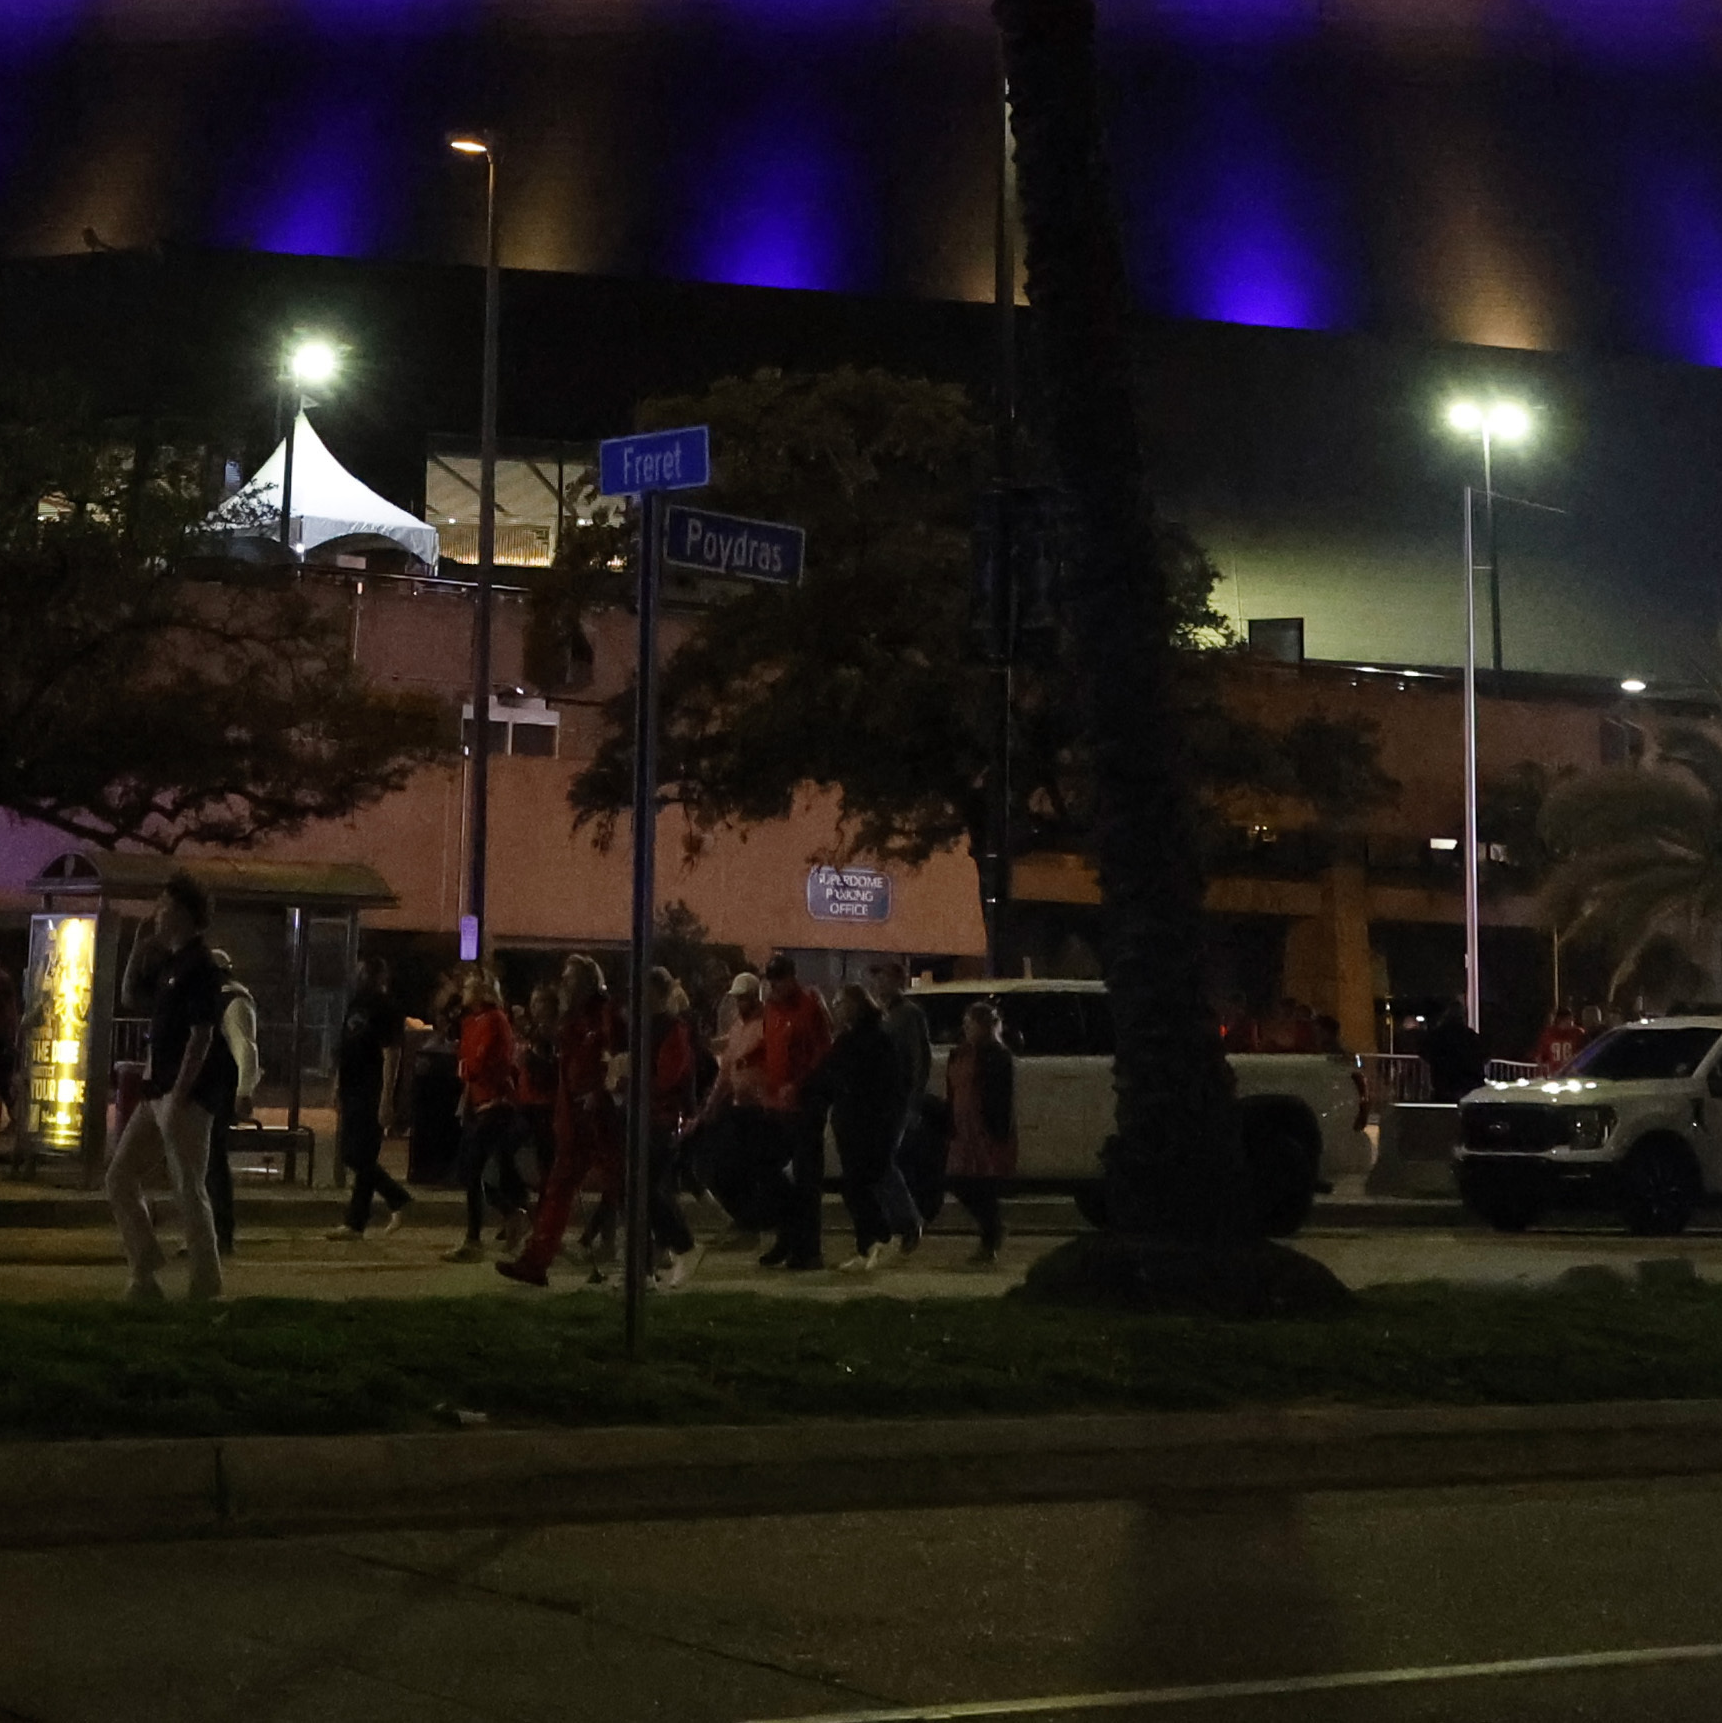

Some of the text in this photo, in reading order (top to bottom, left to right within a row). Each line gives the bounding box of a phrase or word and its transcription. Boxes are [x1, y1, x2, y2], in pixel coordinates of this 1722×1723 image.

[622, 440, 683, 485] Freret
[686, 517, 784, 573] Poydras
[829, 903, 869, 916] OFFICE
[51, 1039, 80, 1064] DE
